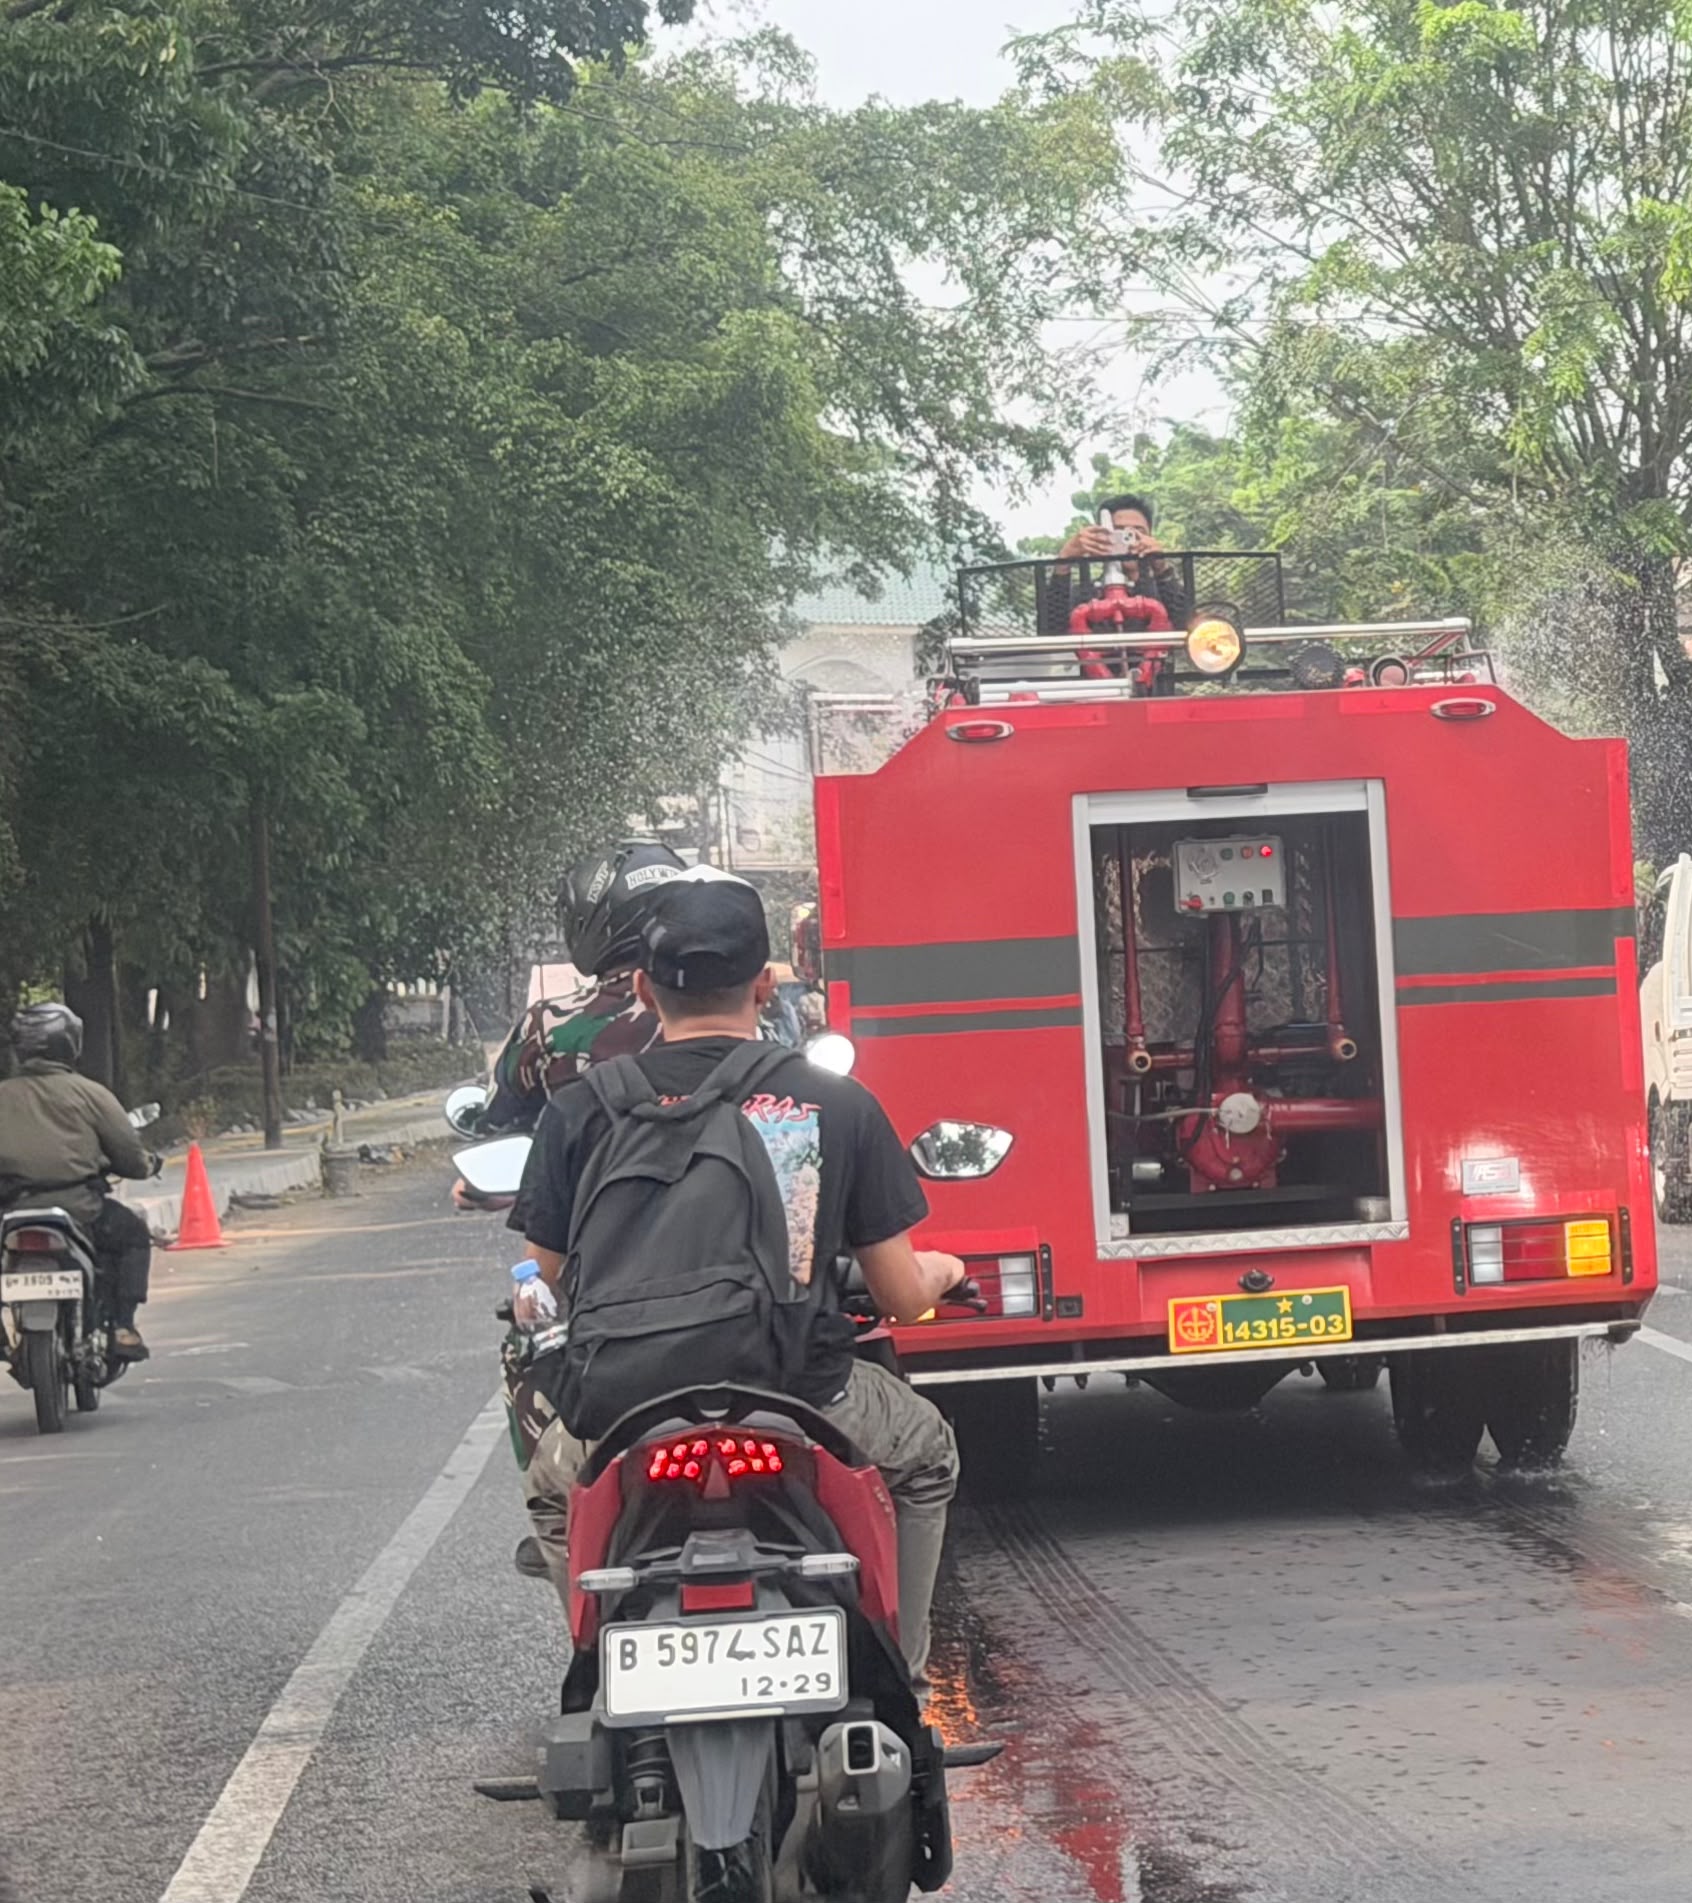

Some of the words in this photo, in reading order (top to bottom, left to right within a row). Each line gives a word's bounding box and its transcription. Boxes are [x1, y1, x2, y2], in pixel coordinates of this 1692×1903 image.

[1224, 1314, 1344, 1342] 14315-03
[619, 1638, 638, 1671] B
[657, 1629, 756, 1667] 5974
[763, 1622, 829, 1659] SAZ
